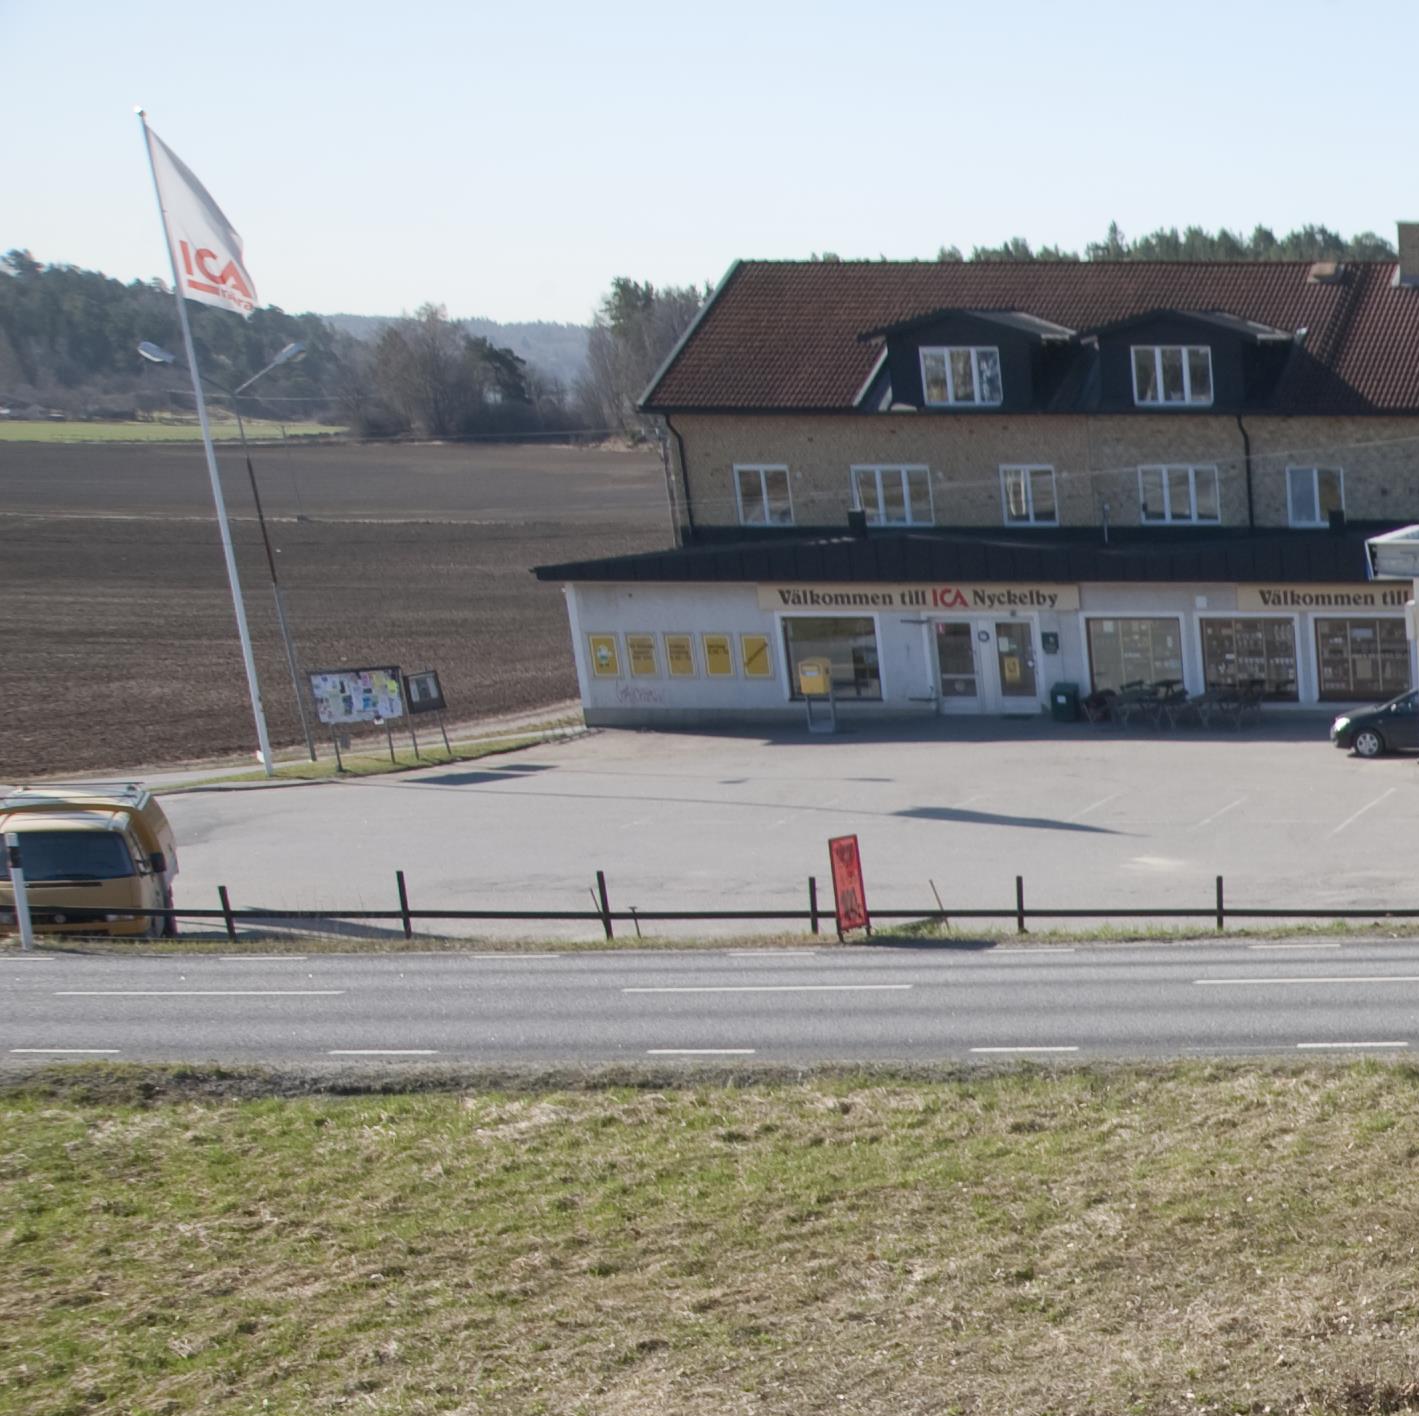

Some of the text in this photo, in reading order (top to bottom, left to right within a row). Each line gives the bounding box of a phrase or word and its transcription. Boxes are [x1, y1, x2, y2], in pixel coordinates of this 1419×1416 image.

[179, 239, 253, 300] ICA
[778, 586, 1059, 609] Välkommen till ICA Nyckelby
[1258, 588, 1375, 606] Välkommen
[1382, 588, 1409, 606] till
